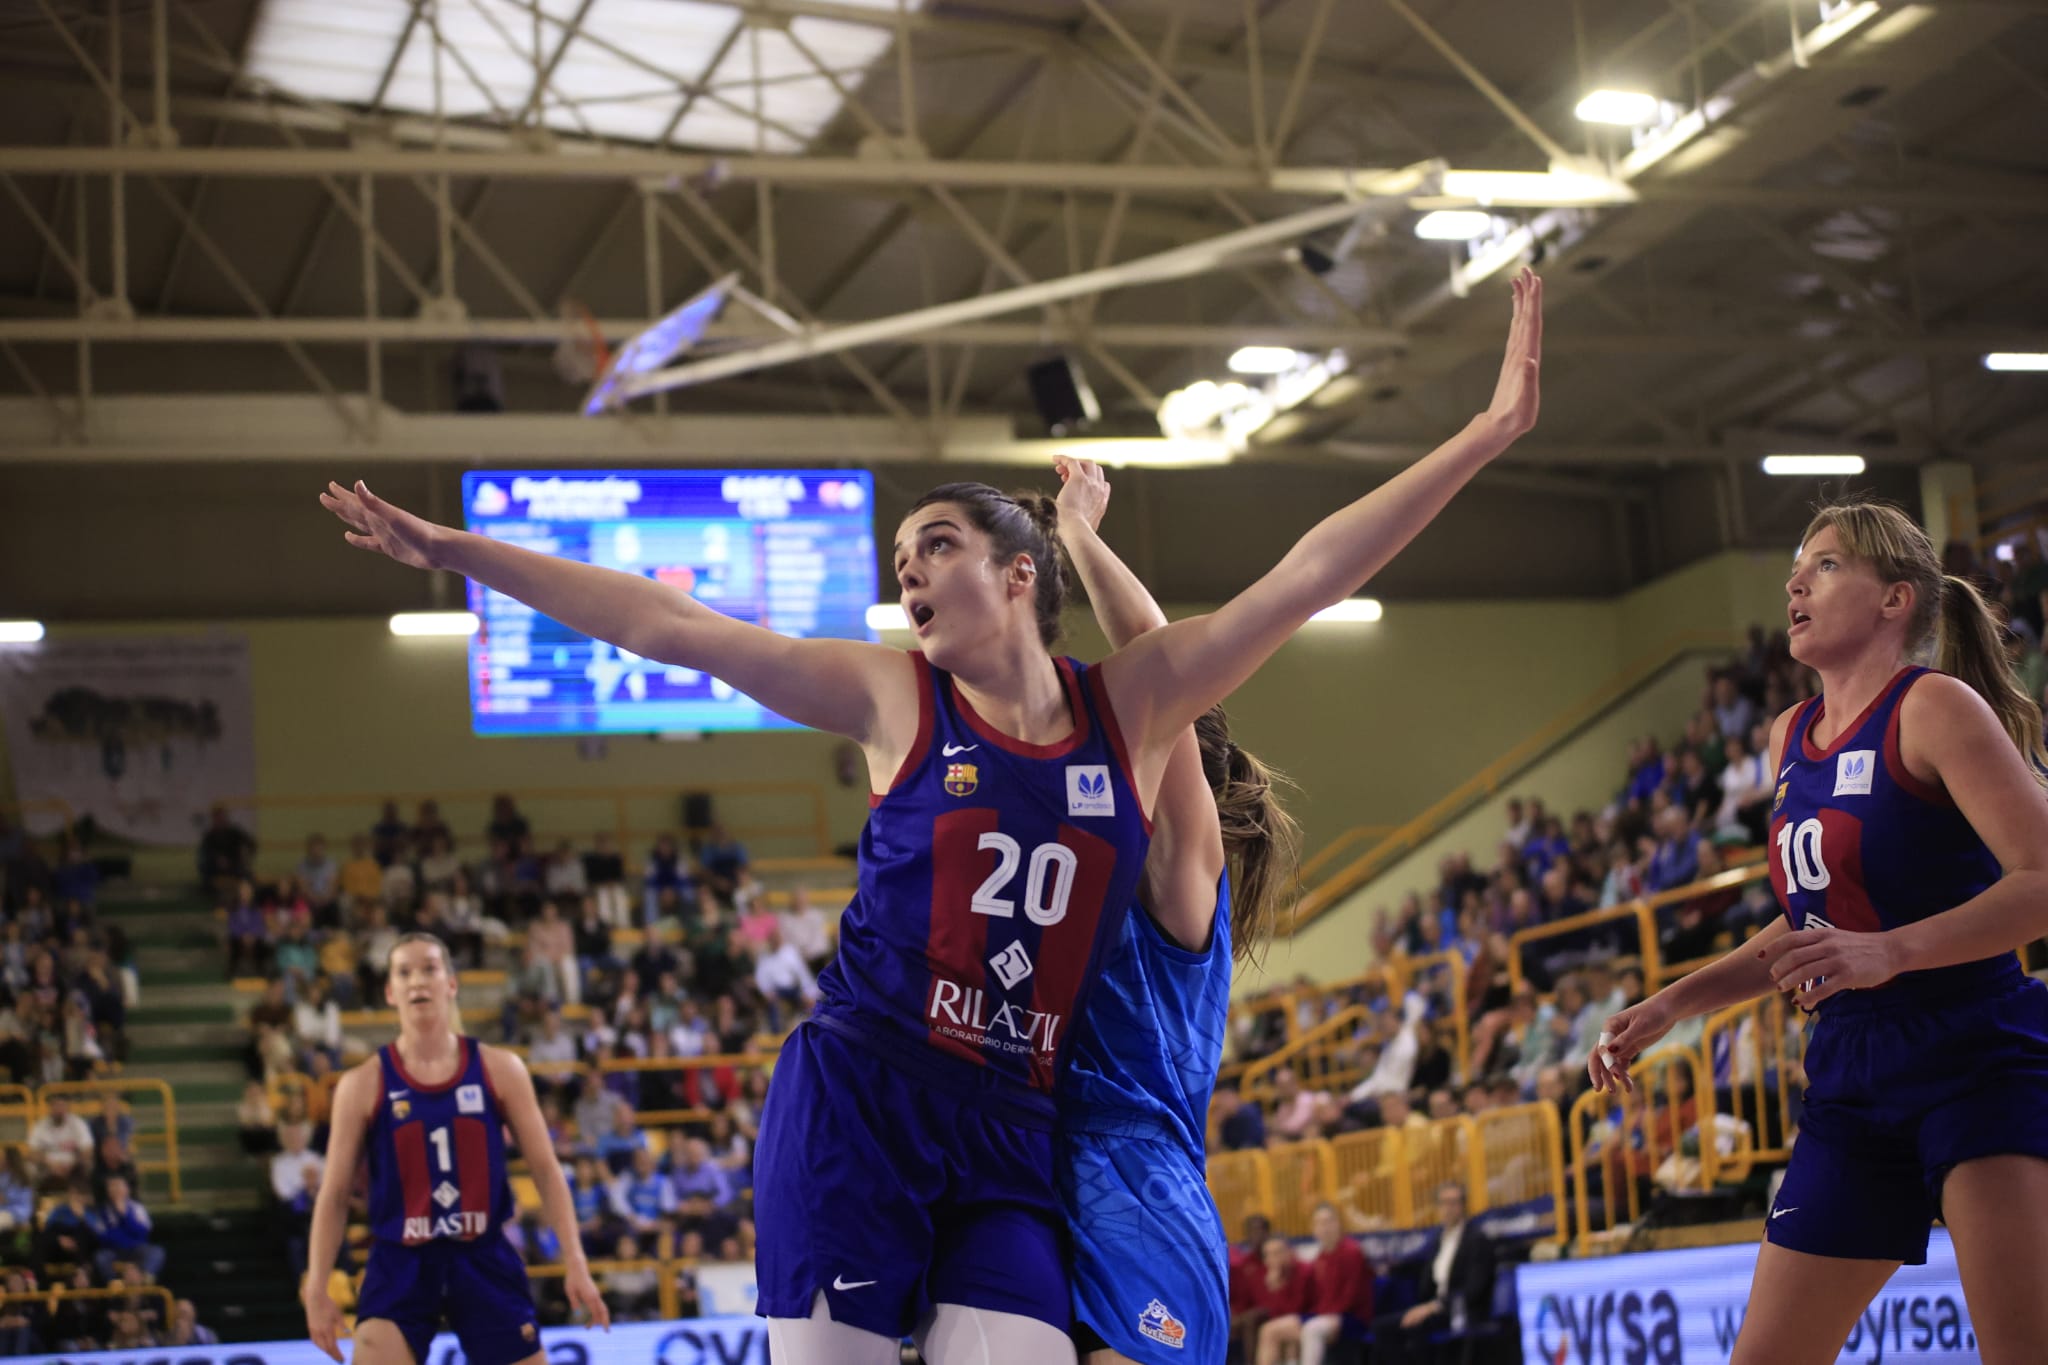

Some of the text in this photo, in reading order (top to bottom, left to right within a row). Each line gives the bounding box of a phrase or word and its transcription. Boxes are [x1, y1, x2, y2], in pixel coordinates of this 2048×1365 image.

[971, 832, 1078, 926] 20
[1777, 818, 1830, 893] 10
[430, 1126, 451, 1171] 1
